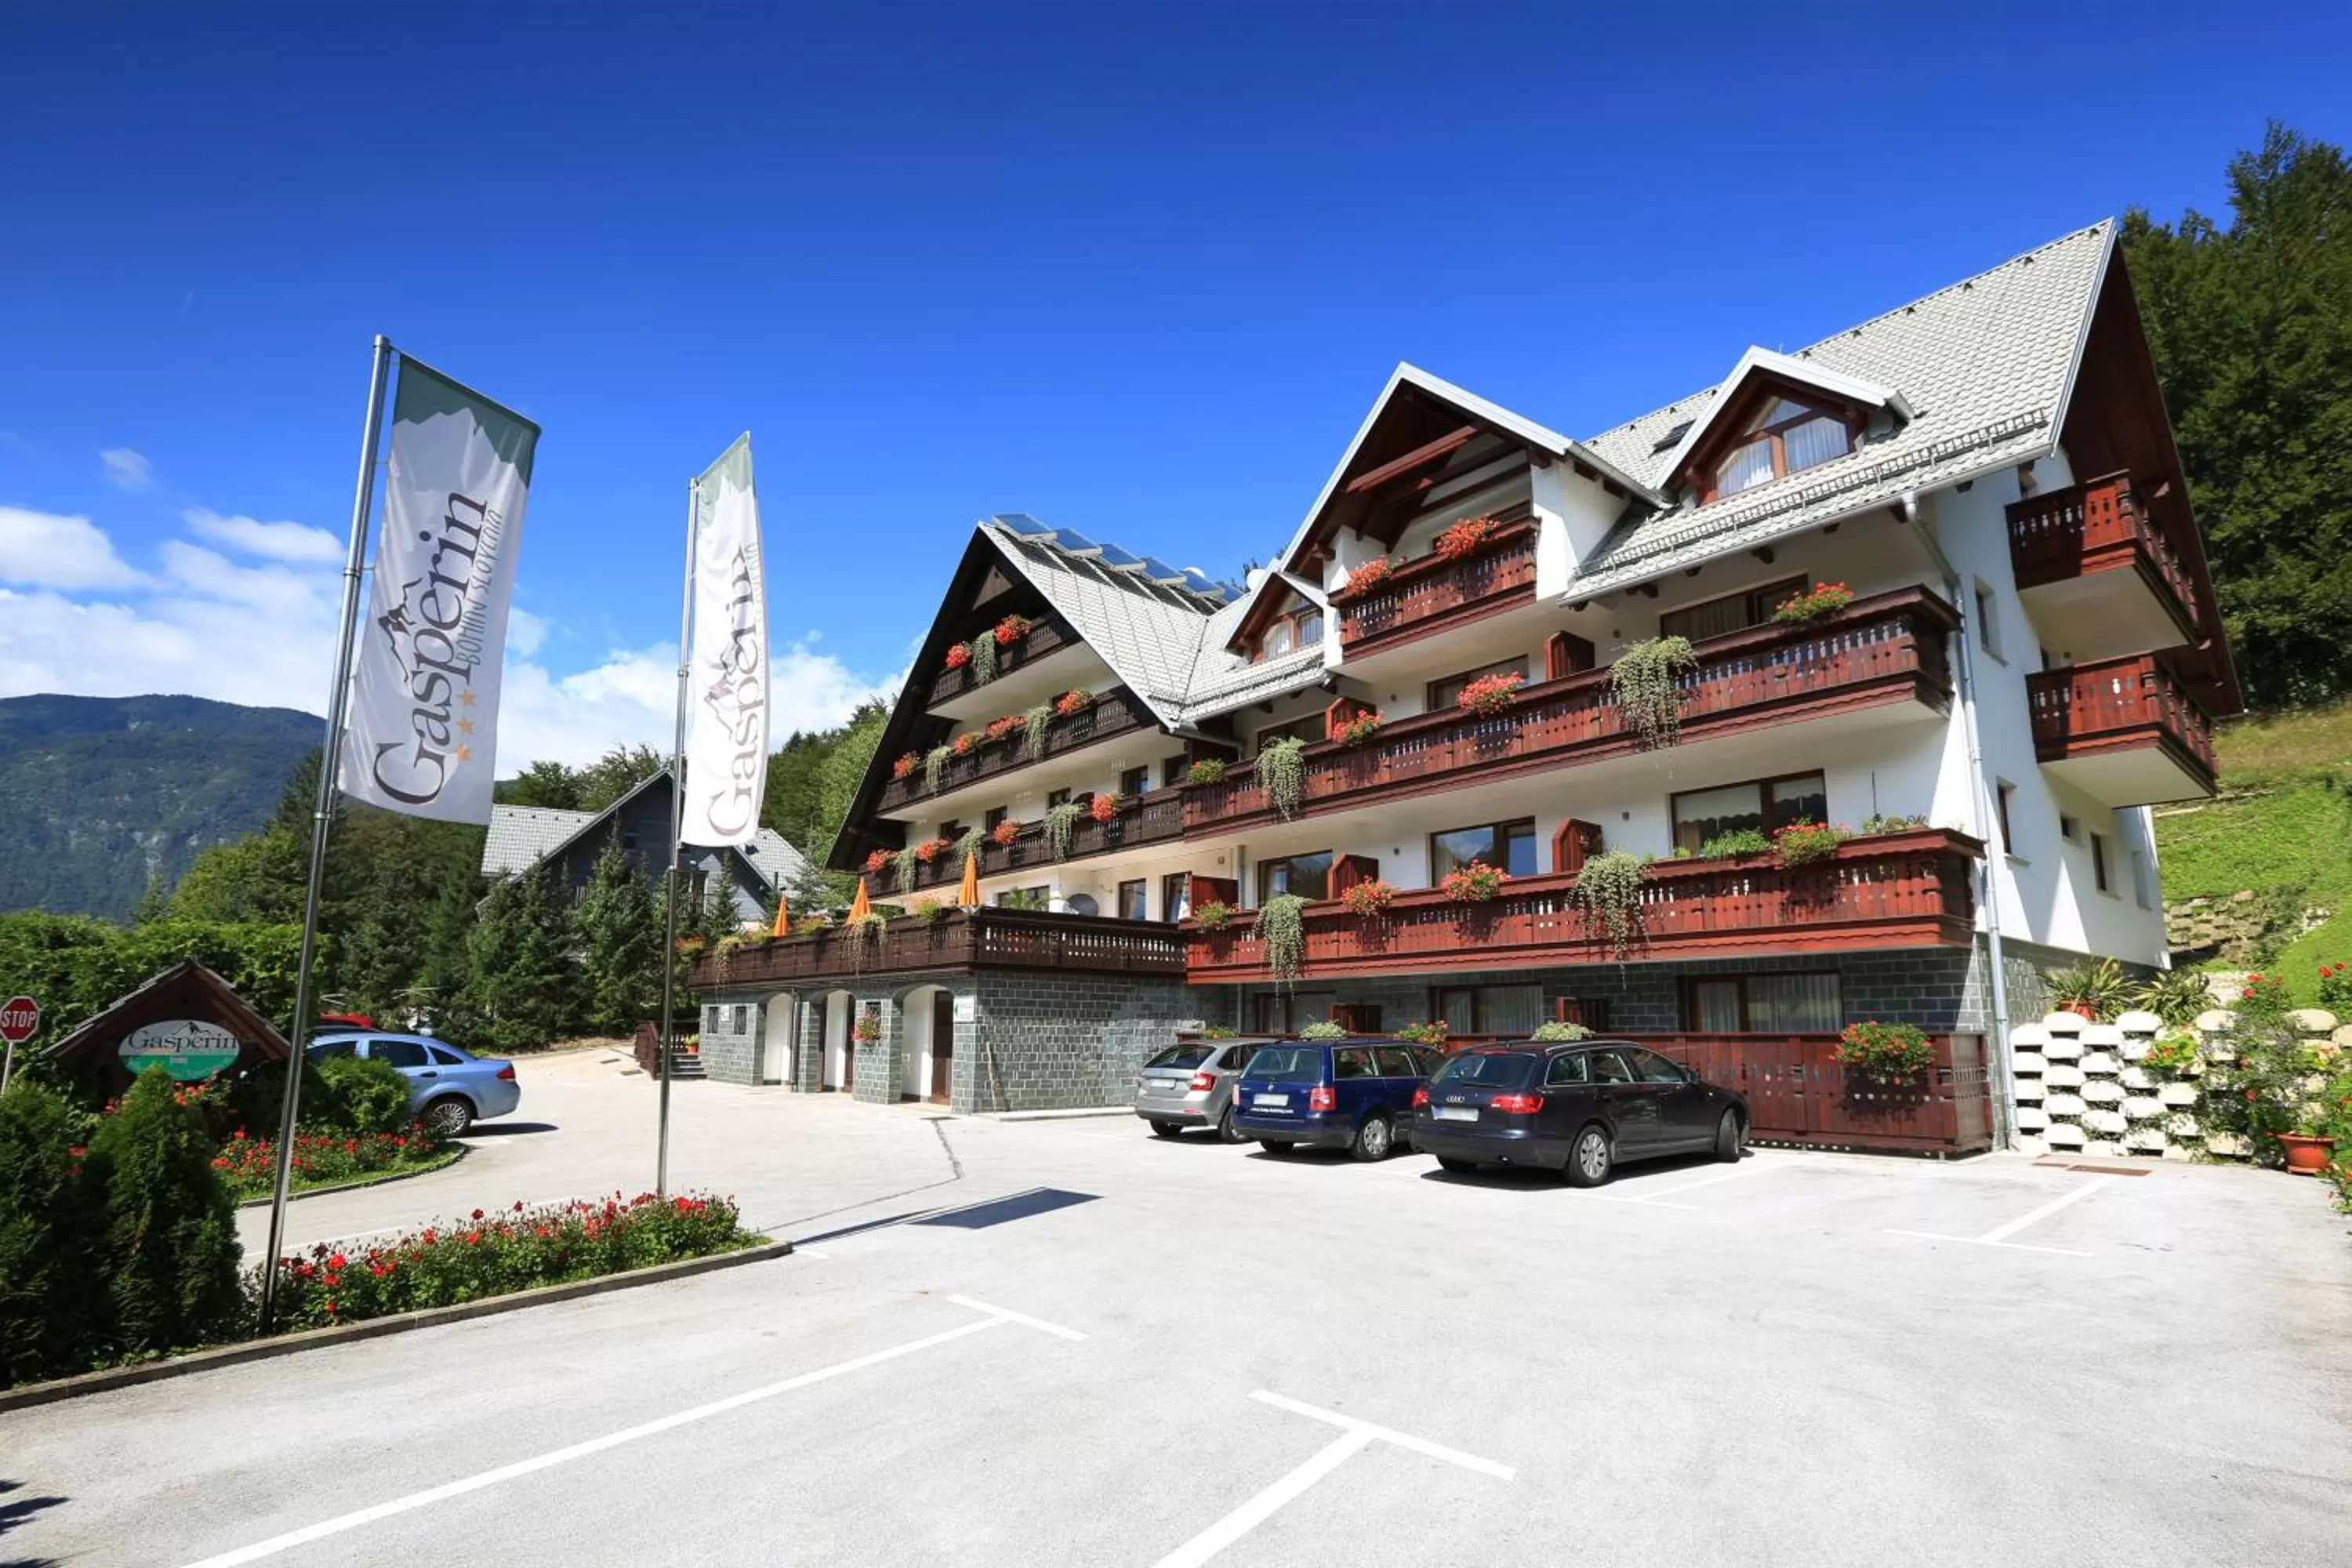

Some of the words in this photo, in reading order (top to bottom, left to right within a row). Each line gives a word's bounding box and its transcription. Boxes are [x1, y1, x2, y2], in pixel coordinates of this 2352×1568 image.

[472, 510, 503, 595] SLOVENIA
[373, 492, 488, 805] Gasperin
[2, 1011, 37, 1028] STOP
[128, 1029, 238, 1053] Gasperin
